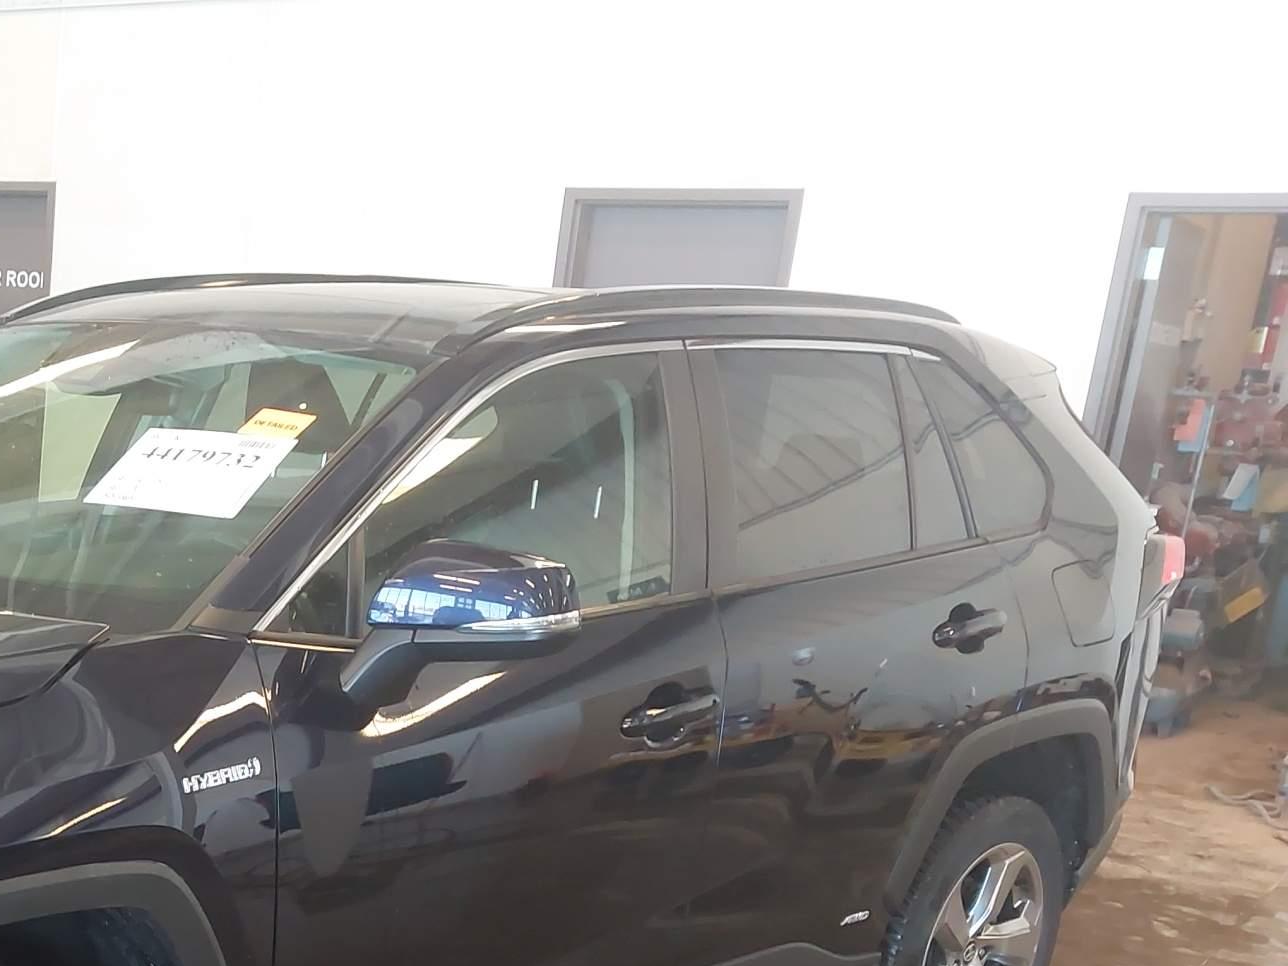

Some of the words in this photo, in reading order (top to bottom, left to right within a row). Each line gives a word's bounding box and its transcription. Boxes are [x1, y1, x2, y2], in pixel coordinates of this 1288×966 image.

[6, 270, 44, 289] ROO
[141, 446, 262, 469] 44179732
[182, 761, 252, 794] HYBRID
